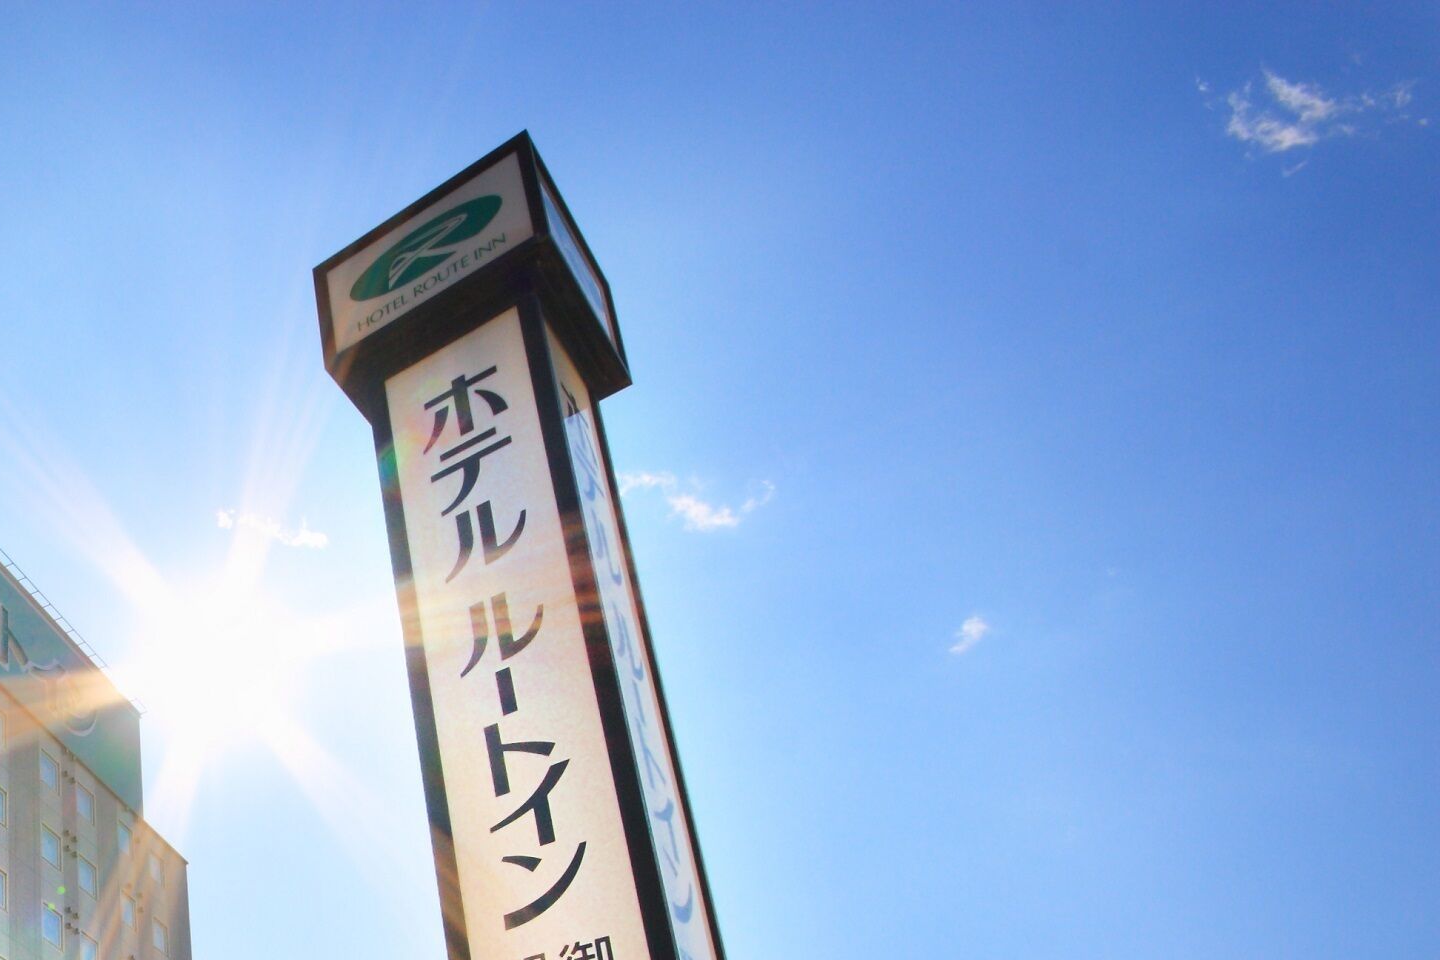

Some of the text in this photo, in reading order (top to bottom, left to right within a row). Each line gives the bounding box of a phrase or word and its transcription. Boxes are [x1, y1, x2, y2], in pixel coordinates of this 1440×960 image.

[357, 233, 507, 332] HOTEL ROUTE INN
